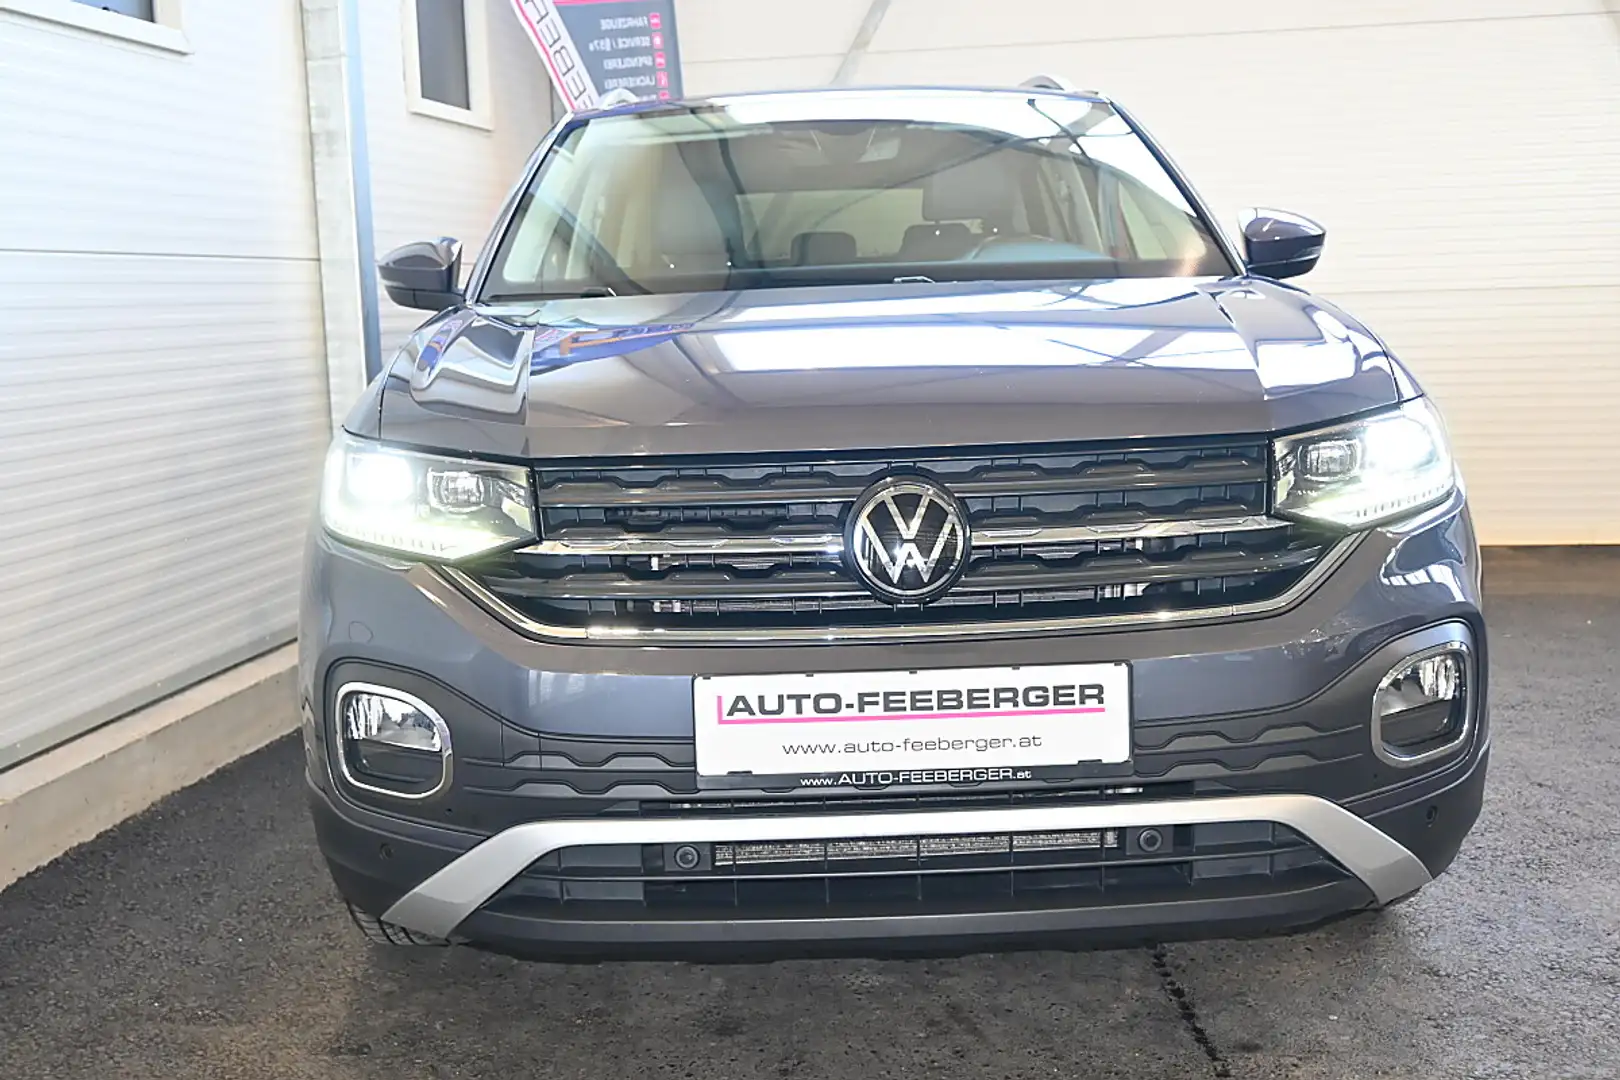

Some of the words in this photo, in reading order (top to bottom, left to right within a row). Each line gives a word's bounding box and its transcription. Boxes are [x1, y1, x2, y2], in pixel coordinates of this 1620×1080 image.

[726, 683, 1105, 717] AUTO-FEEBERGER
[782, 732, 1042, 756] www.auto-feeberger.at
[800, 767, 1032, 787] www.AUTO-FEEBERGER.at
